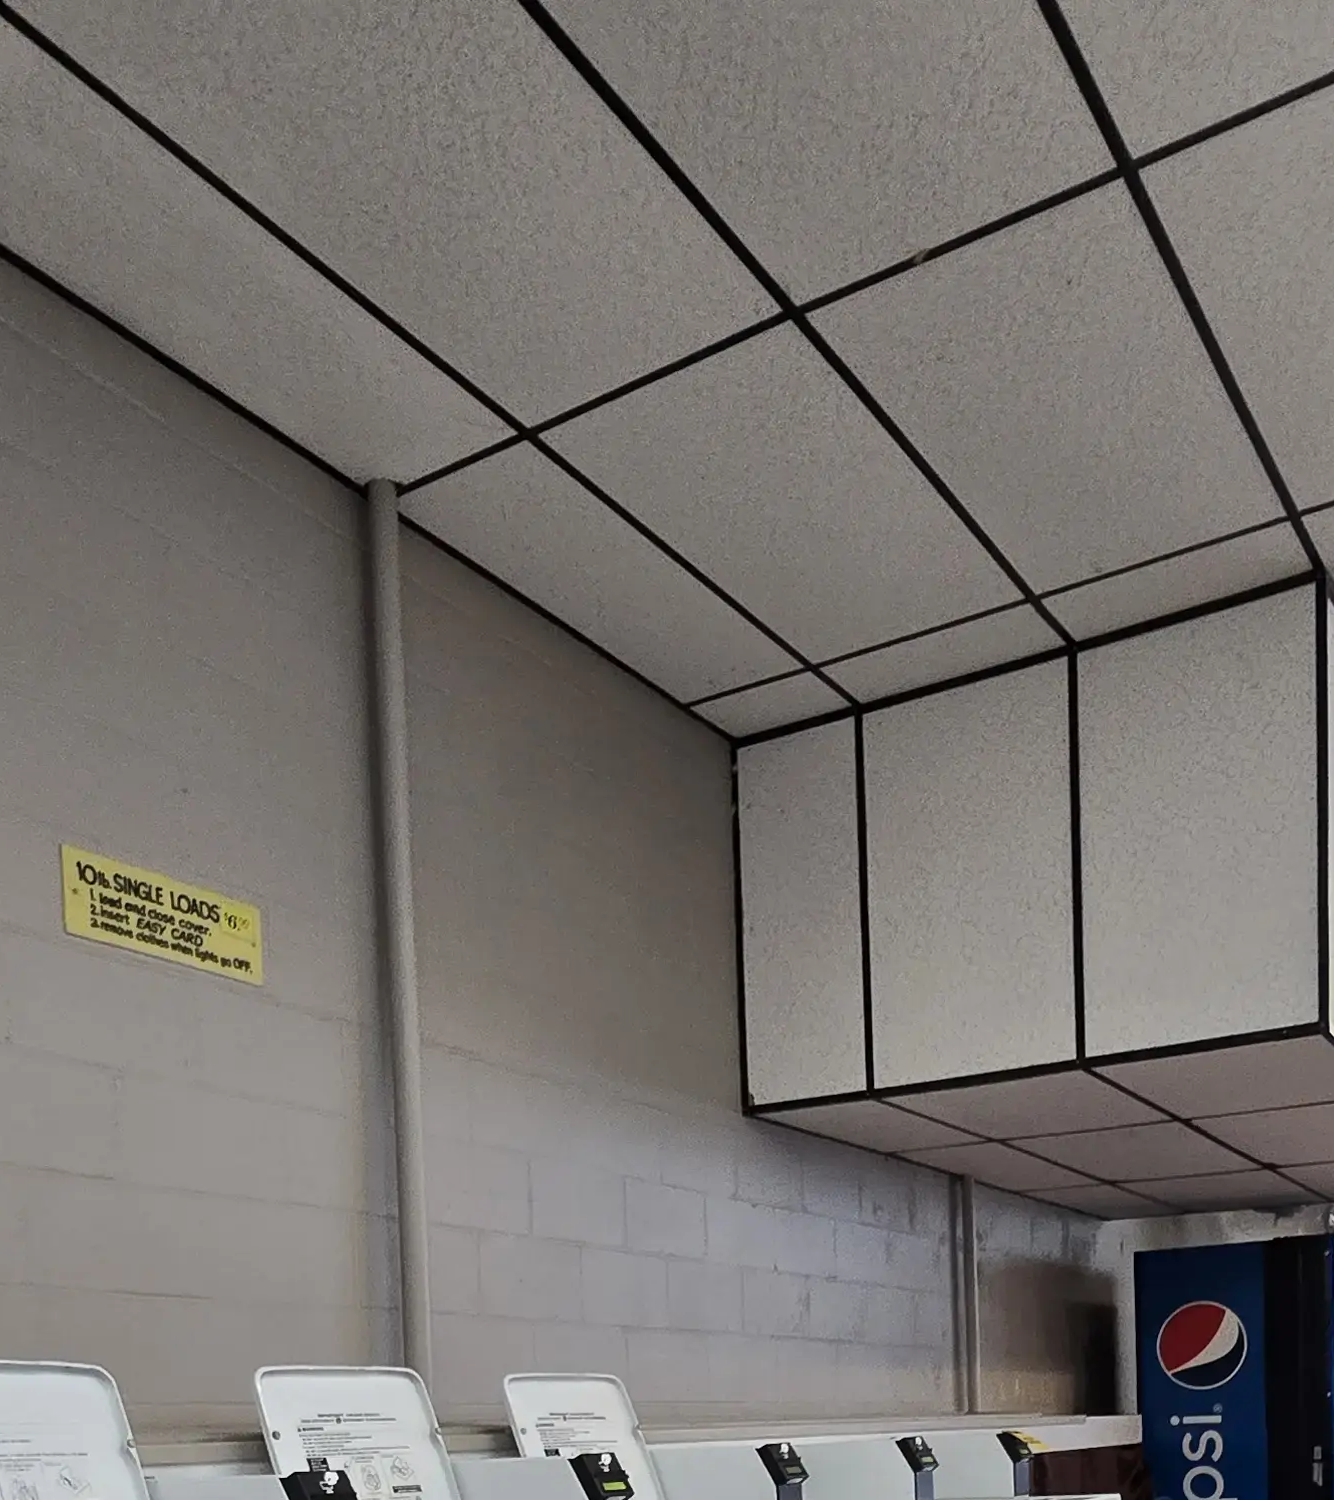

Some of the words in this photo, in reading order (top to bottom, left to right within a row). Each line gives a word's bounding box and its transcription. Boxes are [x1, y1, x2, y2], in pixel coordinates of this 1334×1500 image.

[99, 892, 122, 909] load
[124, 903, 146, 917] and
[148, 909, 175, 926] close
[178, 918, 212, 937] cover.
[113, 873, 164, 906] SINGLE
[170, 891, 221, 923] LOADS
[100, 905, 130, 925] insert
[136, 918, 167, 935] EASY
[171, 928, 203, 947] CARD
[100, 921, 134, 939] remove
[136, 932, 169, 948] clothes
[170, 942, 193, 957] when
[233, 957, 254, 975] OFF.
